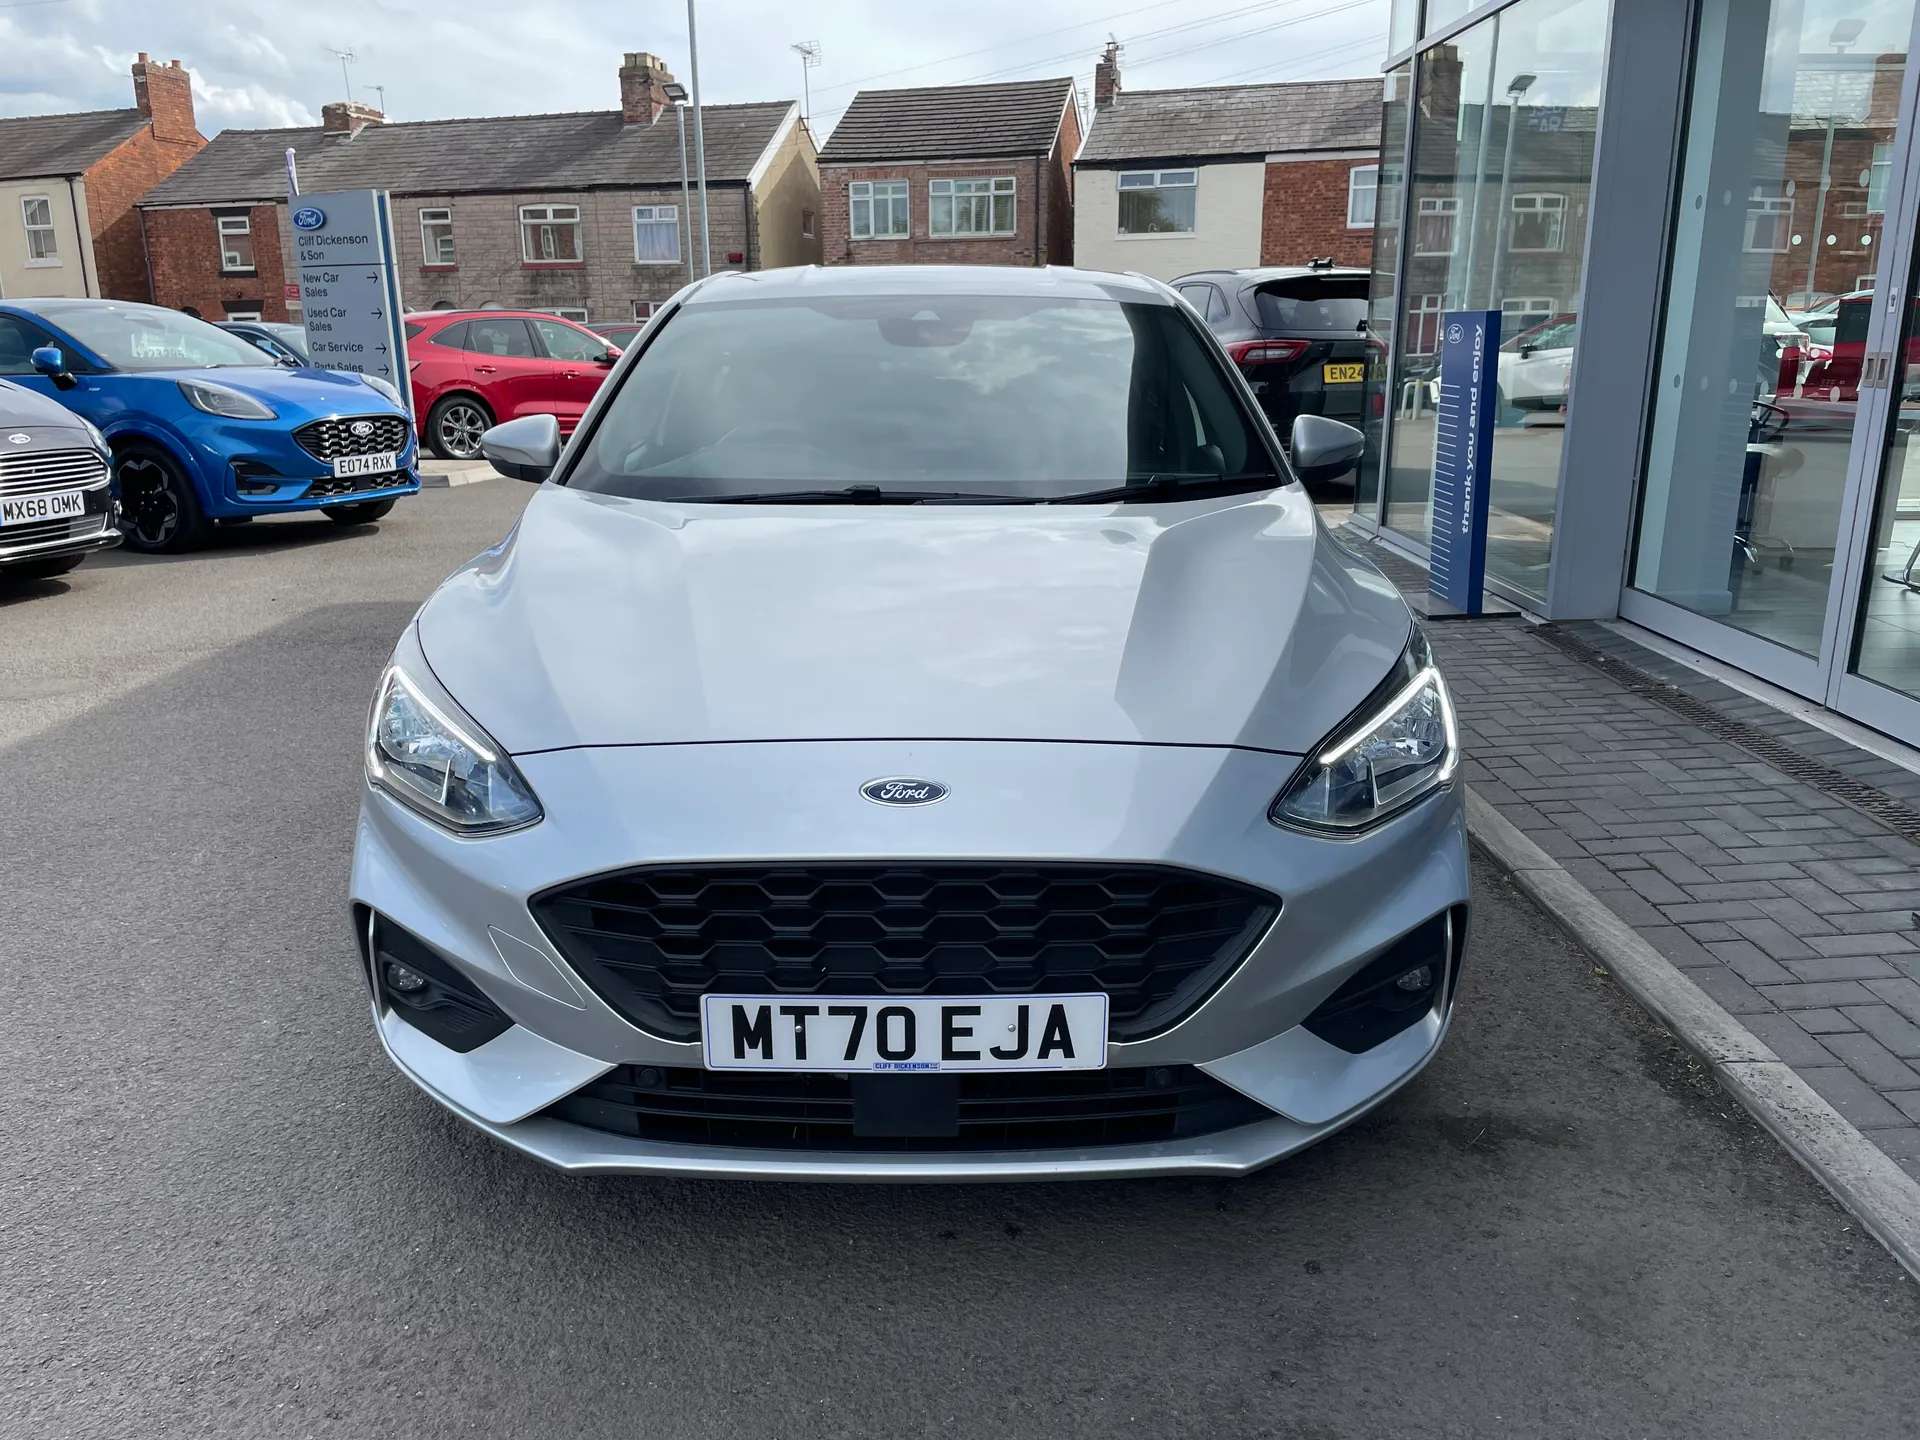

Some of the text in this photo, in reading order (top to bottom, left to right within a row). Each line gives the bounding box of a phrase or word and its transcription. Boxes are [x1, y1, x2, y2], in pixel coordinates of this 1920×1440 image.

[298, 211, 317, 226] Ford
[298, 235, 369, 247] Cliff Dickenson
[300, 250, 325, 261] & Son
[303, 271, 340, 284] New Car
[304, 286, 328, 297] Sales
[307, 307, 347, 318] Used Car
[309, 321, 333, 332] Sales
[311, 341, 364, 352] Car Service
[336, 361, 364, 373] Sales
[1462, 324, 1483, 534] thank you and enjoy
[373, 454, 392, 470] RXK
[3, 494, 81, 521] MX68 OMK
[880, 782, 929, 799] Ford
[731, 1004, 1076, 1061] MT70 EJA
